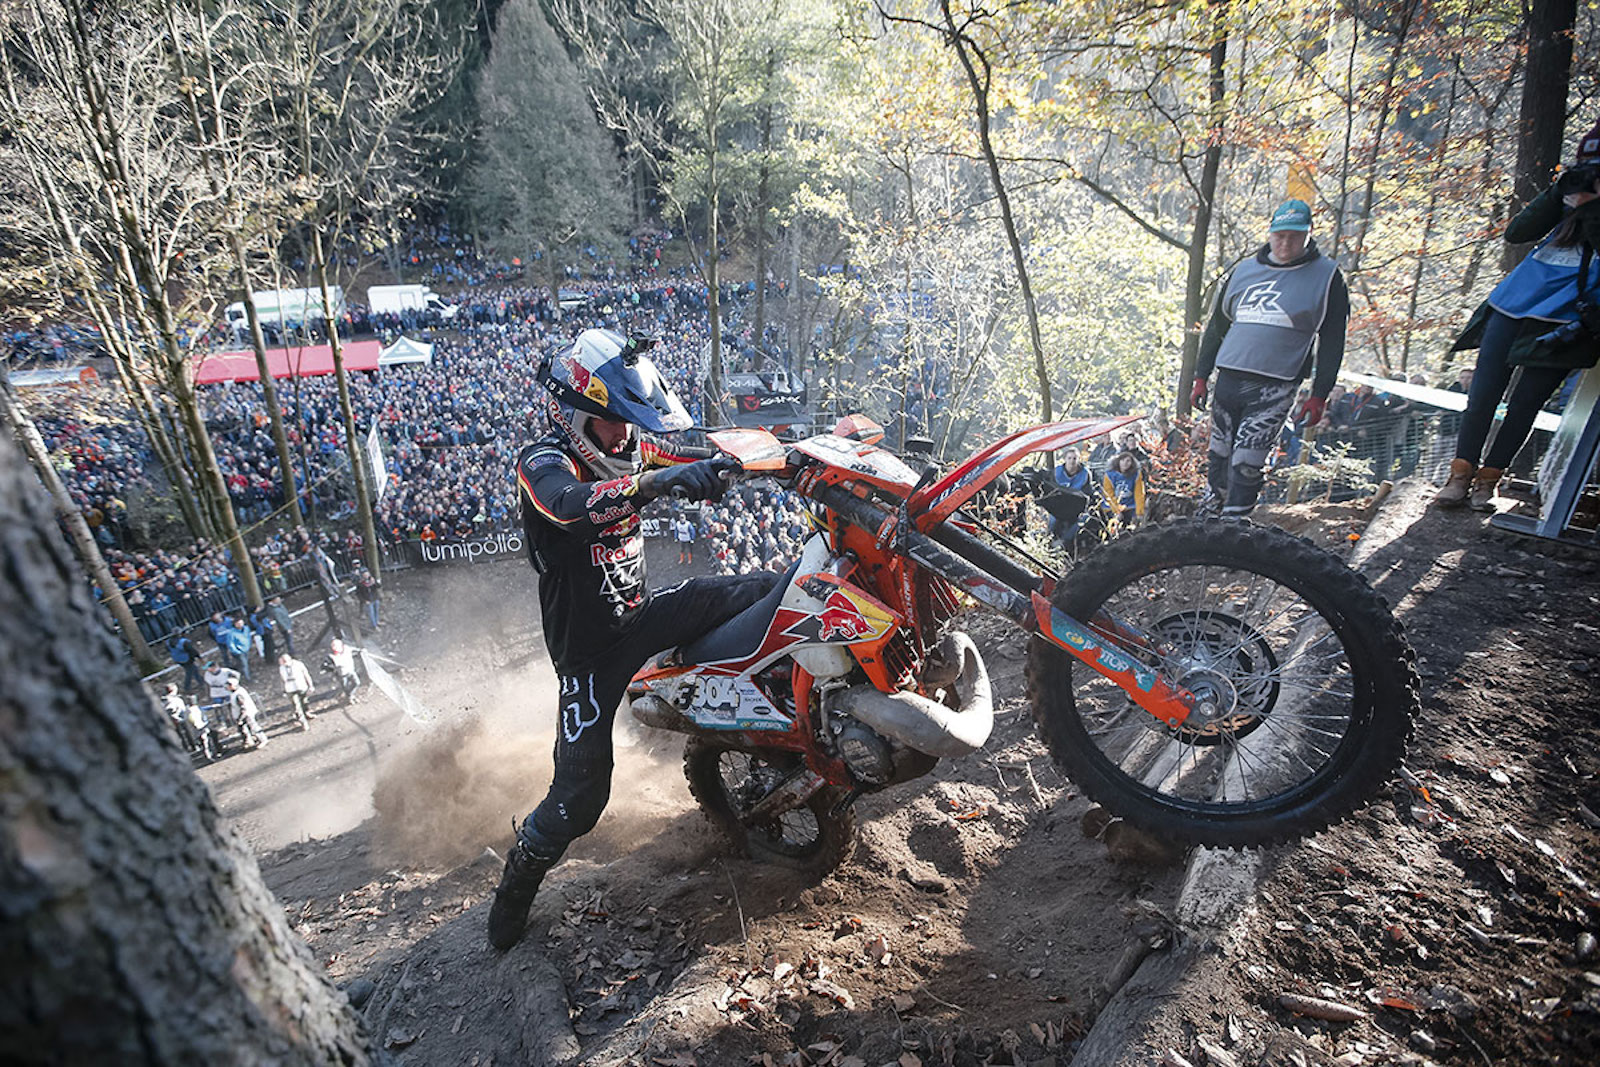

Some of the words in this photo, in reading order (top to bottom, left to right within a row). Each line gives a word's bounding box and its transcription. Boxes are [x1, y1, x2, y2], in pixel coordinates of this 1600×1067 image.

[545, 378, 565, 396] FOX
[589, 507, 613, 525] Red
[610, 500, 637, 517] Bull
[420, 532, 523, 562] lumipöllö
